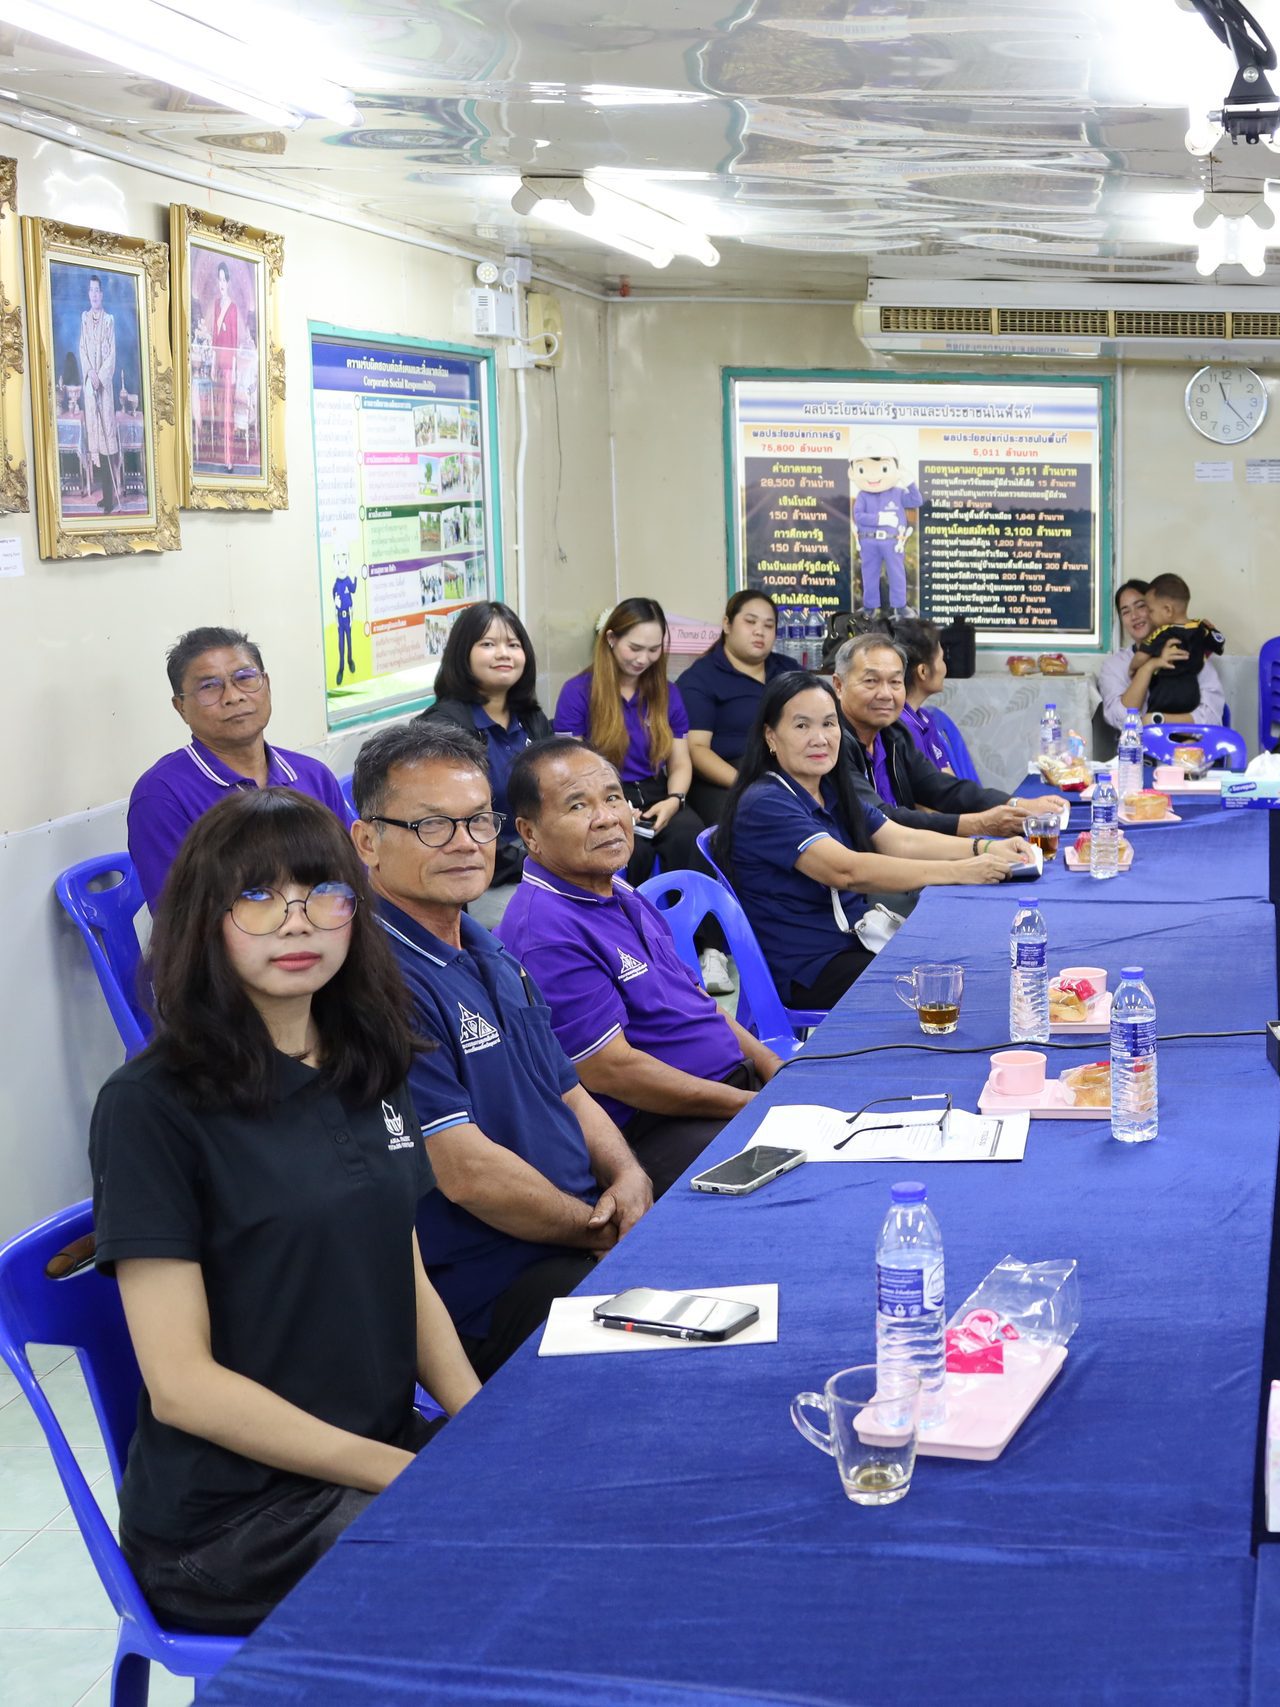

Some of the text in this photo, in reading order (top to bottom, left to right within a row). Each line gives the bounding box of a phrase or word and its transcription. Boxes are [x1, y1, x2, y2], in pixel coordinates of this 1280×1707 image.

[1209, 374, 1217, 383] 11
[1222, 370, 1232, 380] 12
[1238, 374, 1242, 383] 1
[363, 376, 389, 390] Corporate
[389, 378, 404, 389] Social
[1200, 383, 1210, 393] 10
[1246, 383, 1255, 393] 2
[1196, 397, 1204, 407] 9
[1250, 397, 1258, 407] 3
[804, 401, 1032, 419] ผลประโยชน์แก่รัฐบาลและประชาชนในพื้นที่
[1200, 411, 1208, 420] 8
[1246, 411, 1253, 420] 4
[1210, 421, 1218, 431] 7
[1222, 425, 1231, 434] 6
[1236, 421, 1244, 431] 5
[800, 443, 833, 453] ล้านบาท
[973, 447, 1039, 458] 5,011 ล้านบาท
[1010, 466, 1037, 476] 1,911
[1042, 465, 1078, 477] ล้านบาท
[760, 478, 795, 488] 28,500
[1050, 479, 1076, 488] ล้านบาท
[779, 495, 817, 507] เงินโบนัส
[966, 500, 993, 509] ล้านบาท
[769, 509, 828, 521] 150 ล้านบาท
[1038, 513, 1065, 522] ล้านบาท
[1004, 527, 1033, 537] 3,100
[1036, 526, 1072, 537] ล้านบาท
[770, 541, 829, 553] 150 ล้านบาท
[1017, 539, 1043, 548] ล้านบาท
[1035, 550, 1062, 559] ล้านบาท
[1062, 562, 1089, 571] ล้านบาท
[763, 575, 836, 586] 10,000 ล้านบาท
[1019, 572, 1046, 581] ล้านบาท
[1045, 584, 1072, 593] ล้านบาท
[771, 593, 840, 608] ษีเงินได้นิติบุคคล
[1020, 595, 1047, 603] ล้านบาท
[1025, 605, 1052, 614] ล้านบาท
